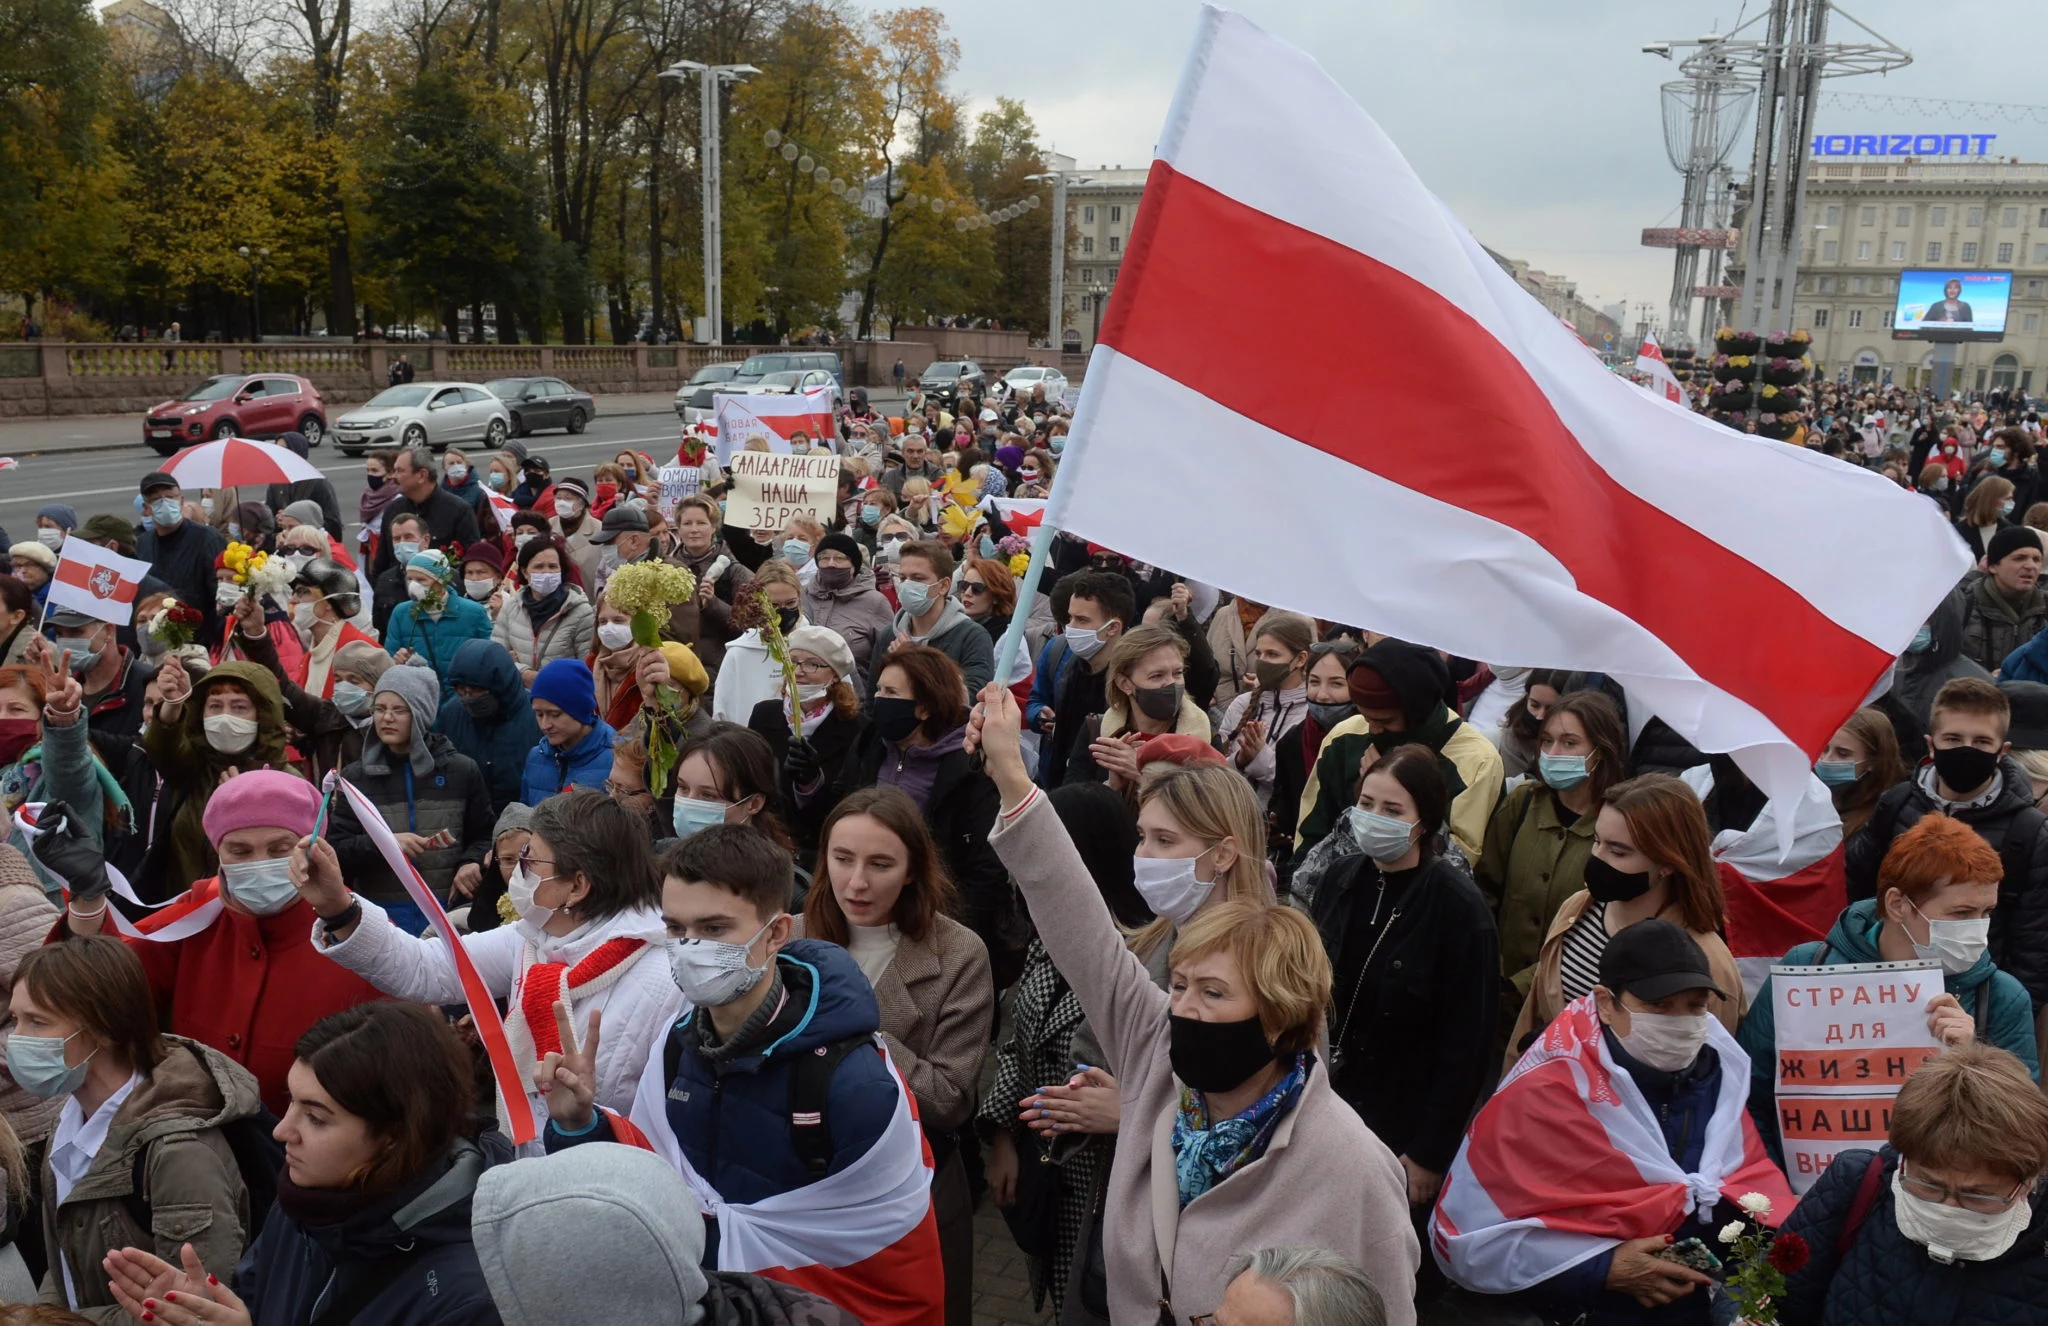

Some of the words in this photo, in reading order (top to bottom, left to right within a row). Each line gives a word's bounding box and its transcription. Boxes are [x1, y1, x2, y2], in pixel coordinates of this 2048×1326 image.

[662, 469, 698, 483] ОМОН
[730, 454, 839, 479] САЛІДАРНАСЦЬ
[661, 483, 699, 498] ВОЮЕТ
[761, 482, 808, 504] НАША
[1786, 983, 1922, 1008] СТРАНУ
[1825, 1022, 1887, 1044] ДЛЯ
[1780, 1056, 1930, 1080] ЖИЗН
